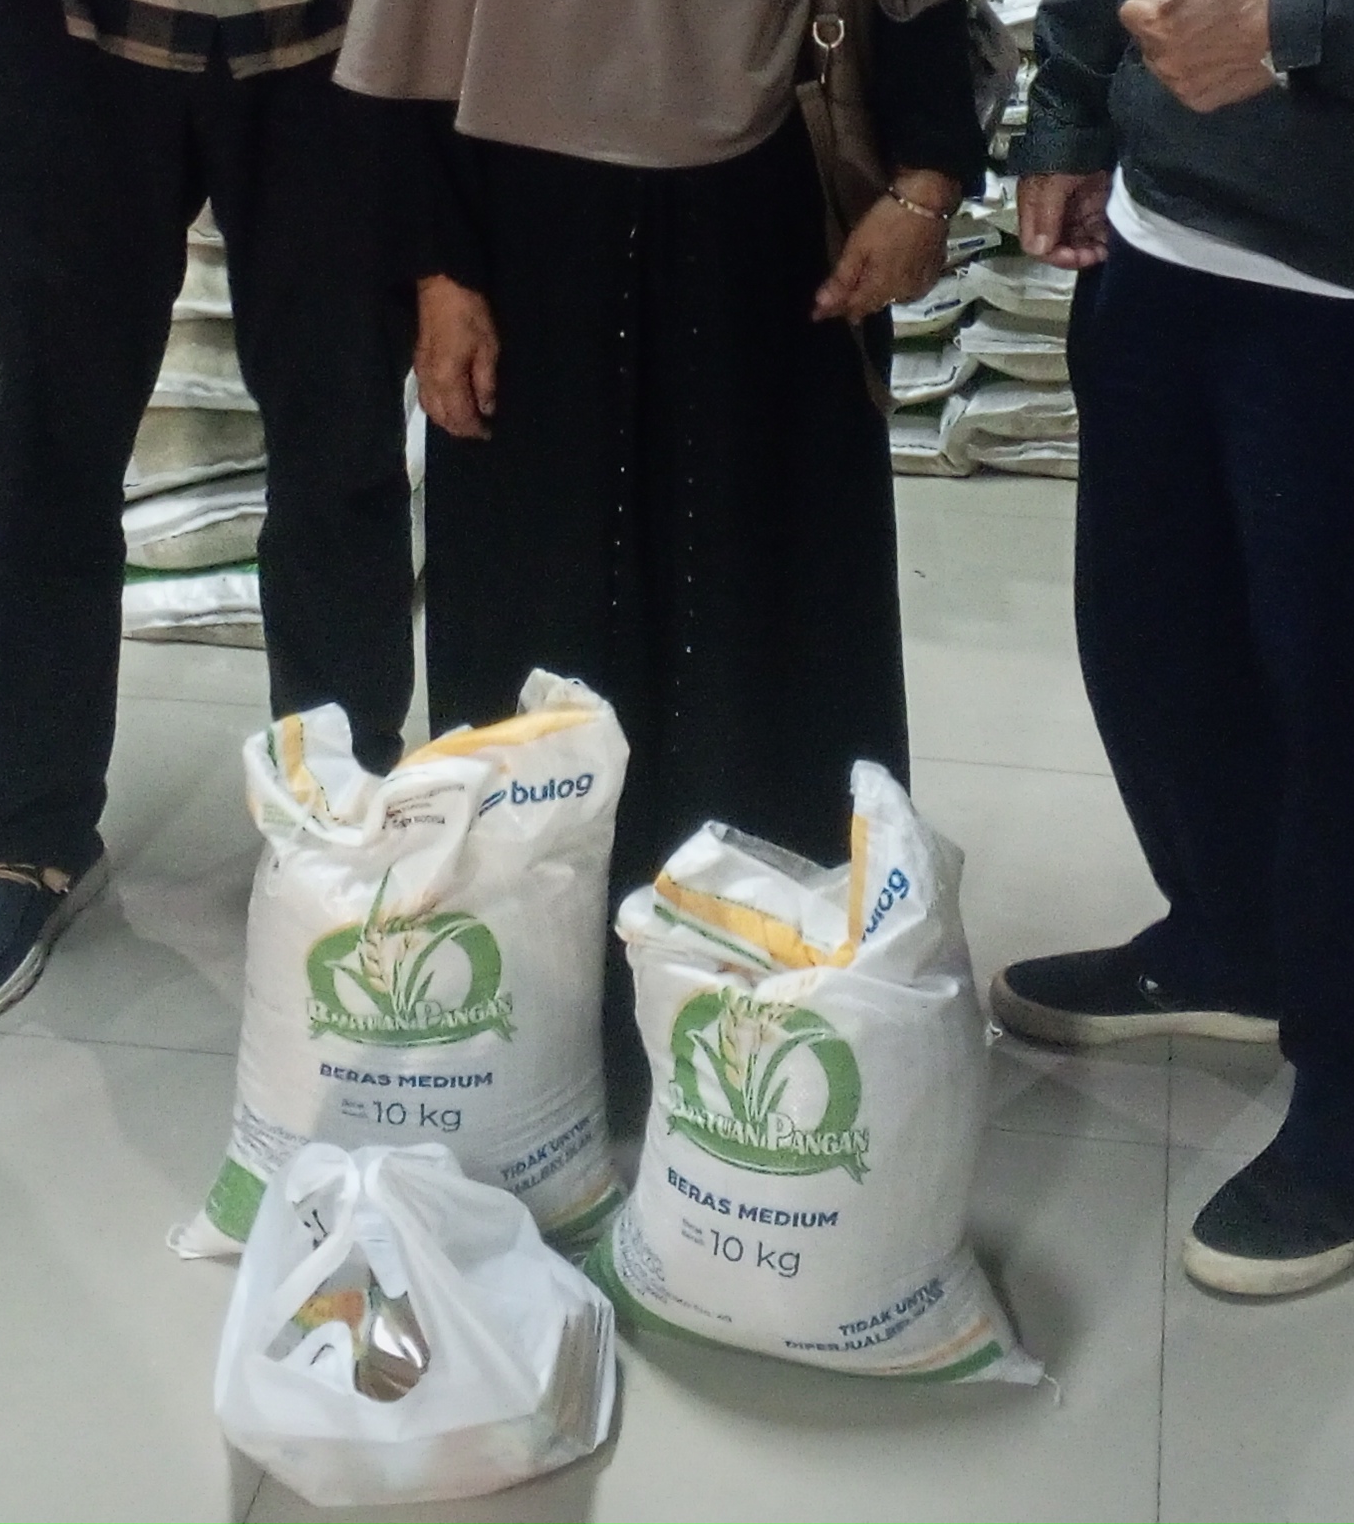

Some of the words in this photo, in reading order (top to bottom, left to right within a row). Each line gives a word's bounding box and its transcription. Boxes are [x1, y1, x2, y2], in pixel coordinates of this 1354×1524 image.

[511, 773, 594, 805] bulog
[862, 867, 910, 943] ulog
[414, 993, 514, 1029] PANGAN
[319, 1063, 392, 1087] BERAS
[397, 1072, 494, 1089] MEDIUM
[373, 1100, 407, 1126] 10
[420, 1102, 462, 1133] kg
[766, 1111, 870, 1157] PANGAN
[667, 1167, 732, 1216] BERAS
[738, 1203, 839, 1228] MEDIUM
[710, 1229, 744, 1263] 10
[757, 1241, 801, 1278] kg
[838, 1308, 892, 1337] TIDAK
